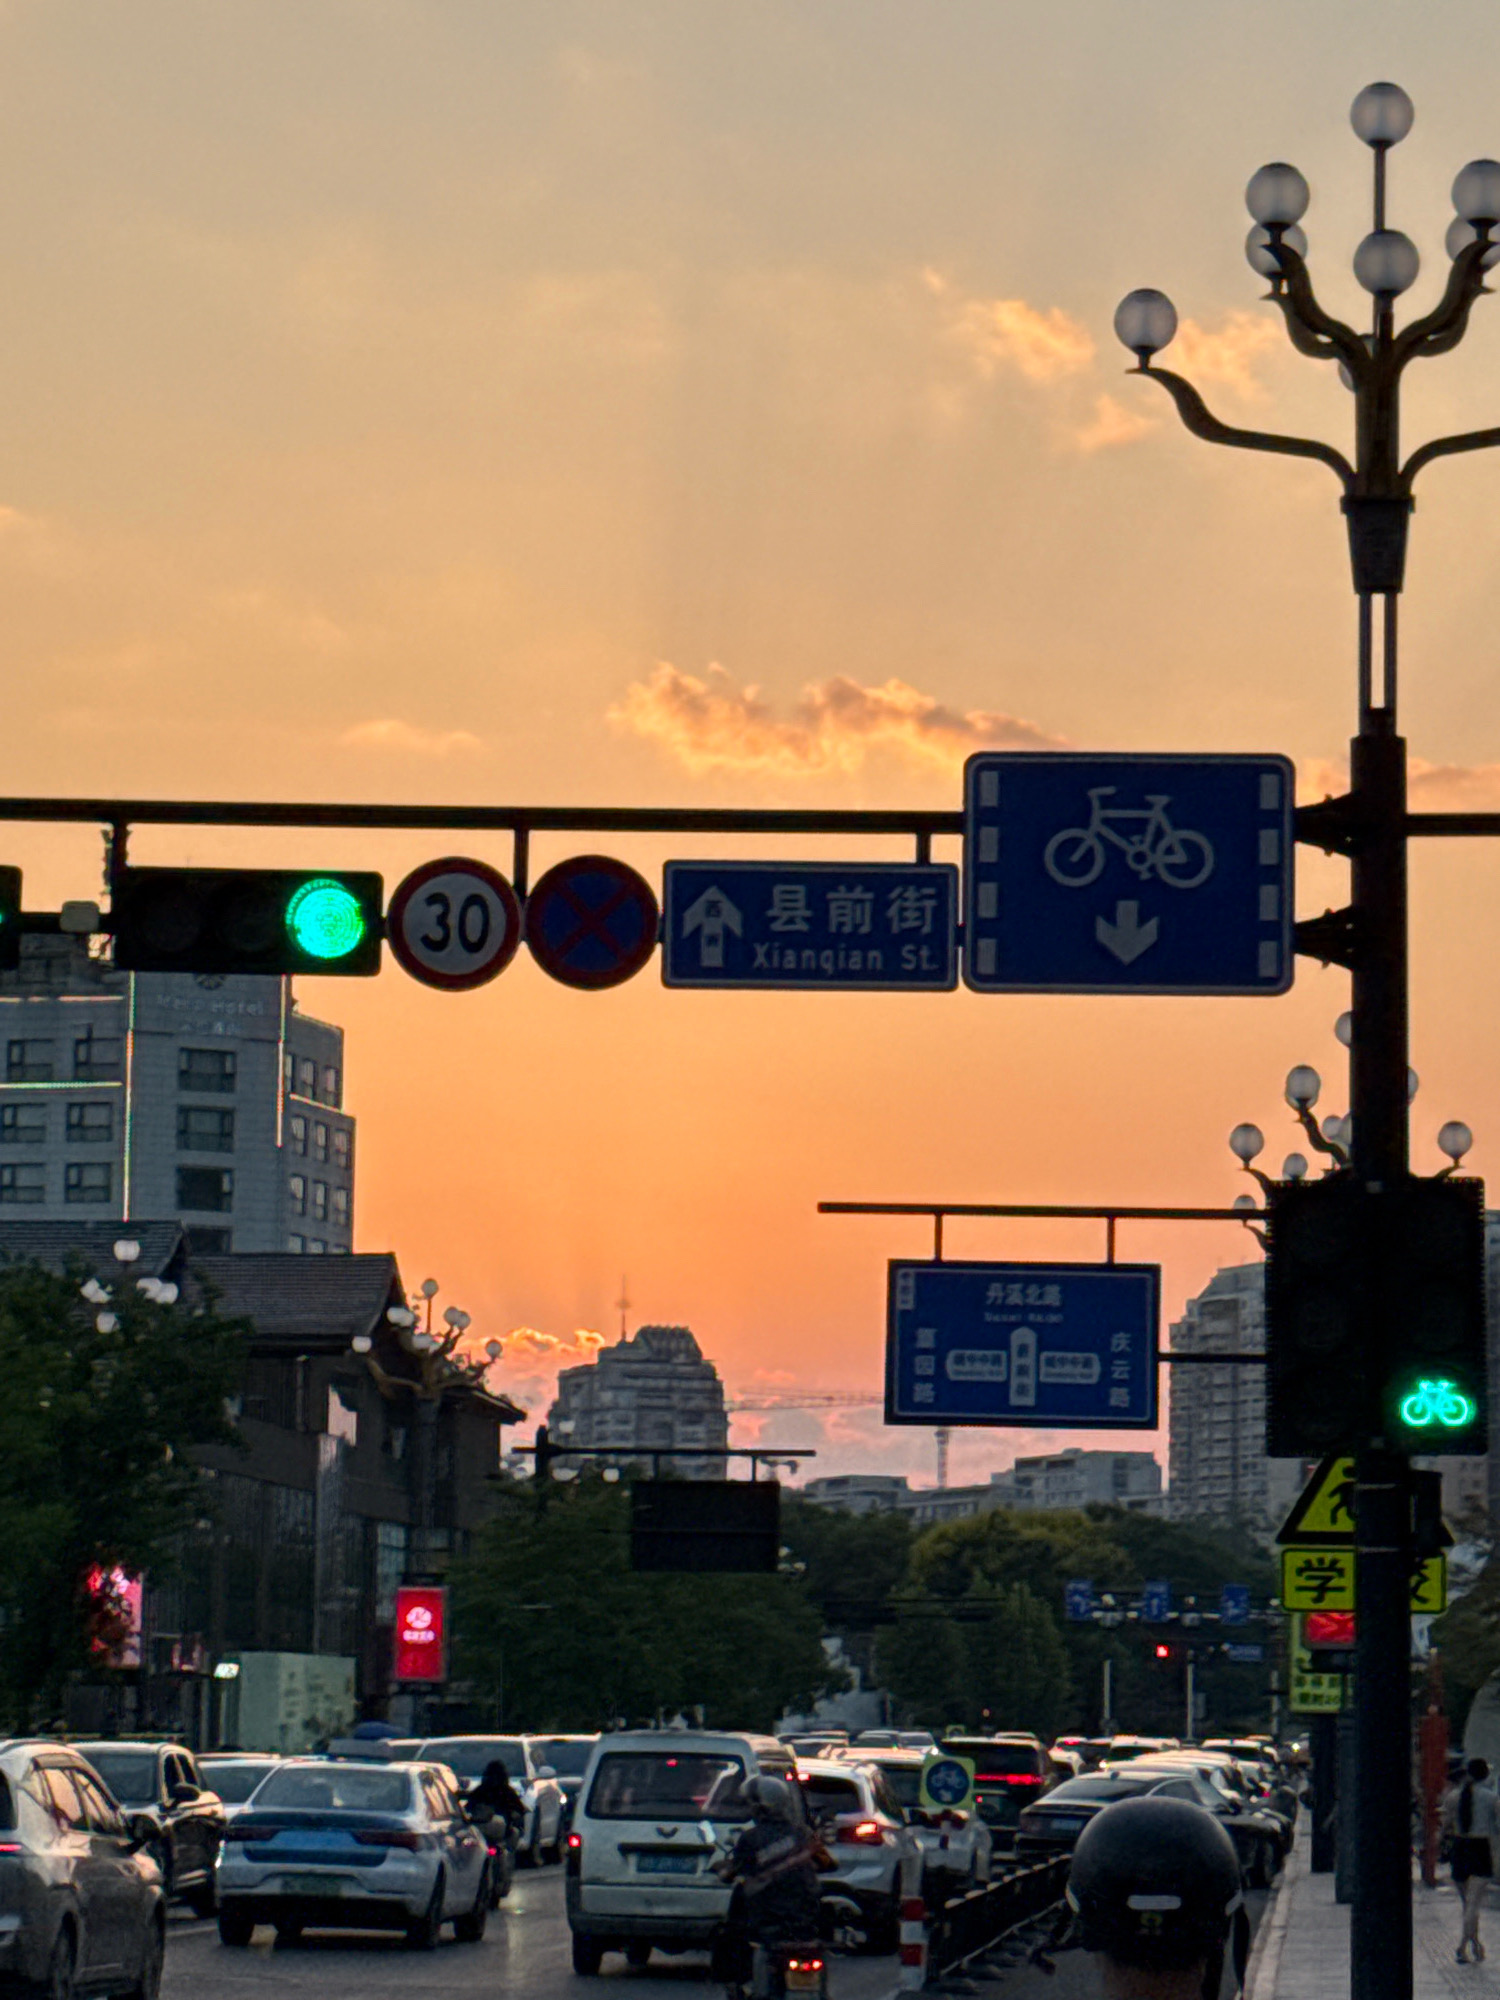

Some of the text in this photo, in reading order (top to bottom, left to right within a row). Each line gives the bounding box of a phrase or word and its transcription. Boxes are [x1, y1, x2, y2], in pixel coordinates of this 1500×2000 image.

[420, 892, 490, 954] 30
[765, 884, 941, 936] 县前街
[752, 942, 942, 976] Xianqian St.
